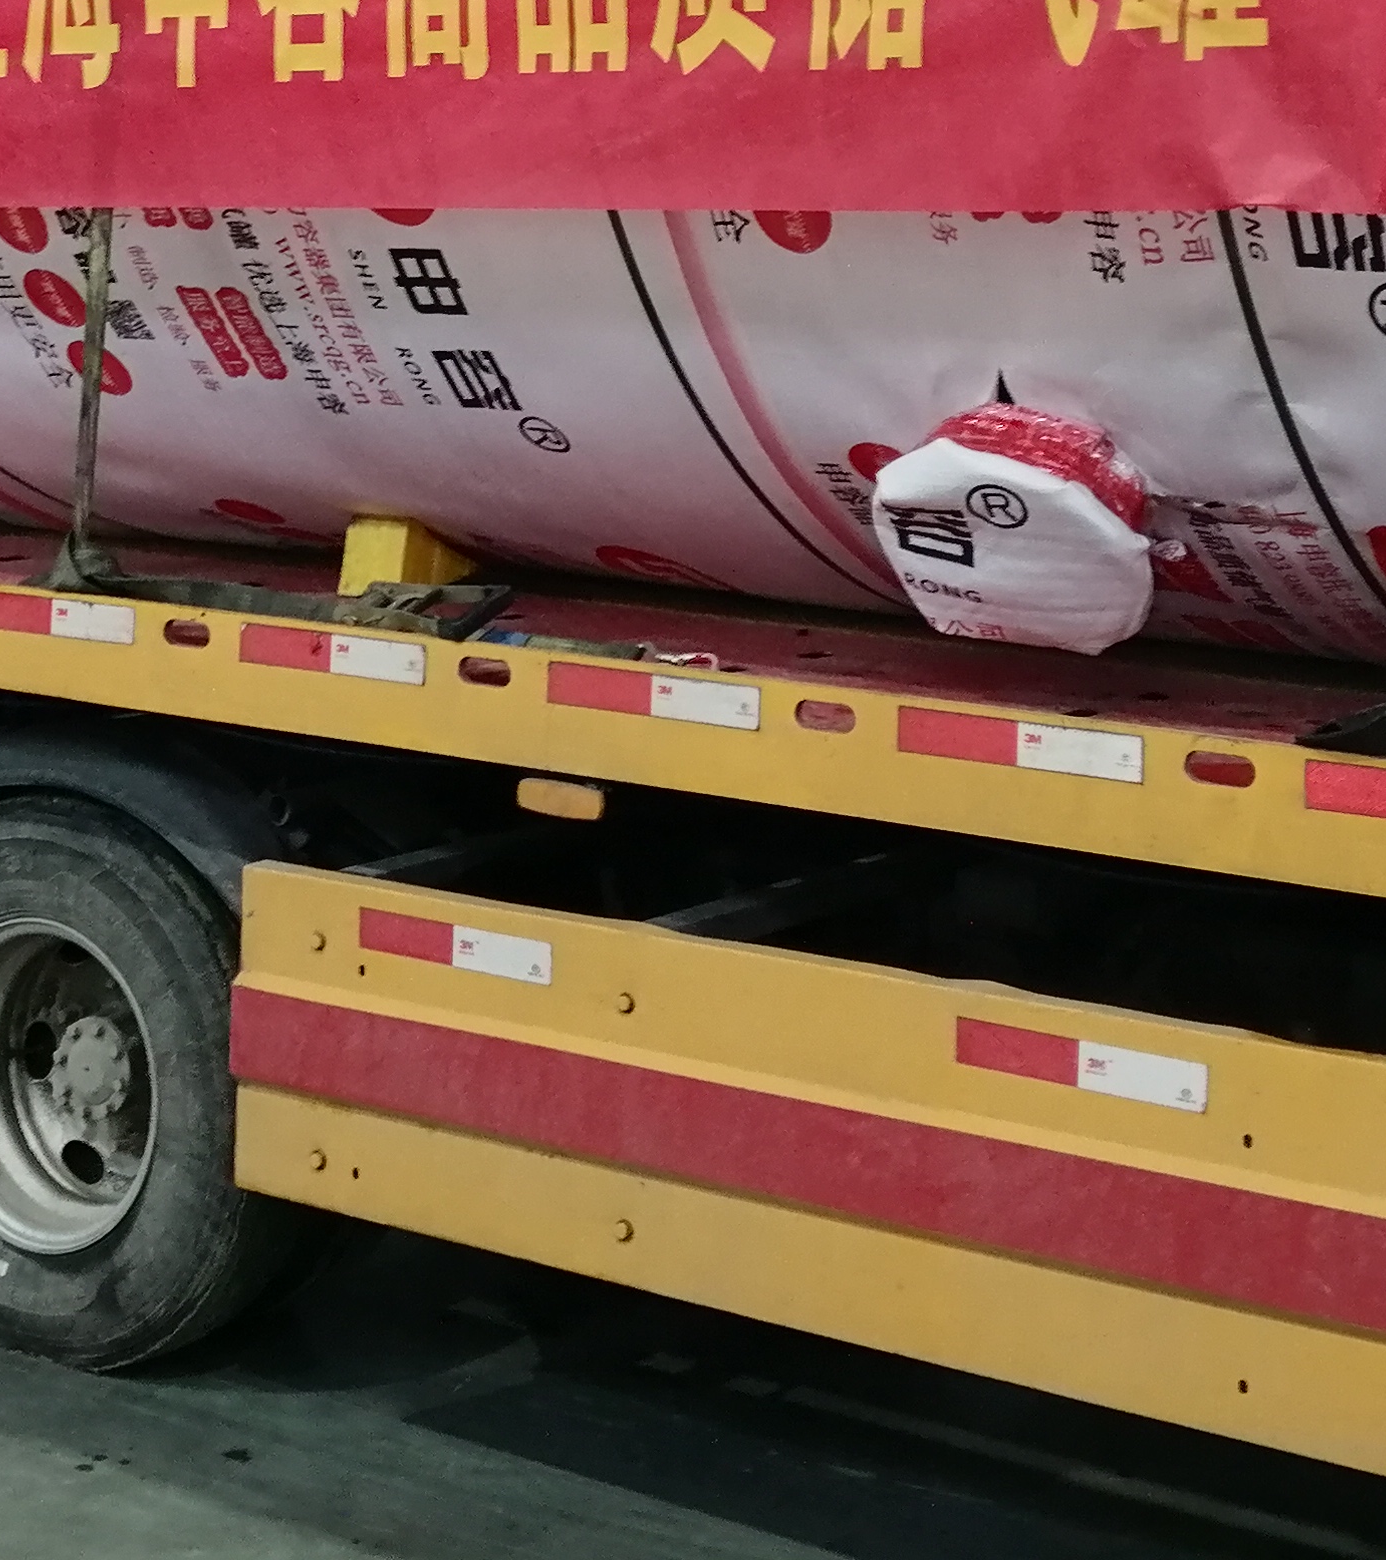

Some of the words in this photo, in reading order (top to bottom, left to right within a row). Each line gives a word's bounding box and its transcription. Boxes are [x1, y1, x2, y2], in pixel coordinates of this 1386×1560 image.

[241, 258, 350, 415] 优选上海申容
[275, 237, 371, 406] www.srcqg.cn
[348, 248, 388, 311] SHEN
[395, 346, 442, 406] RONG
[389, 248, 523, 411] 申容
[905, 573, 982, 603] RONG
